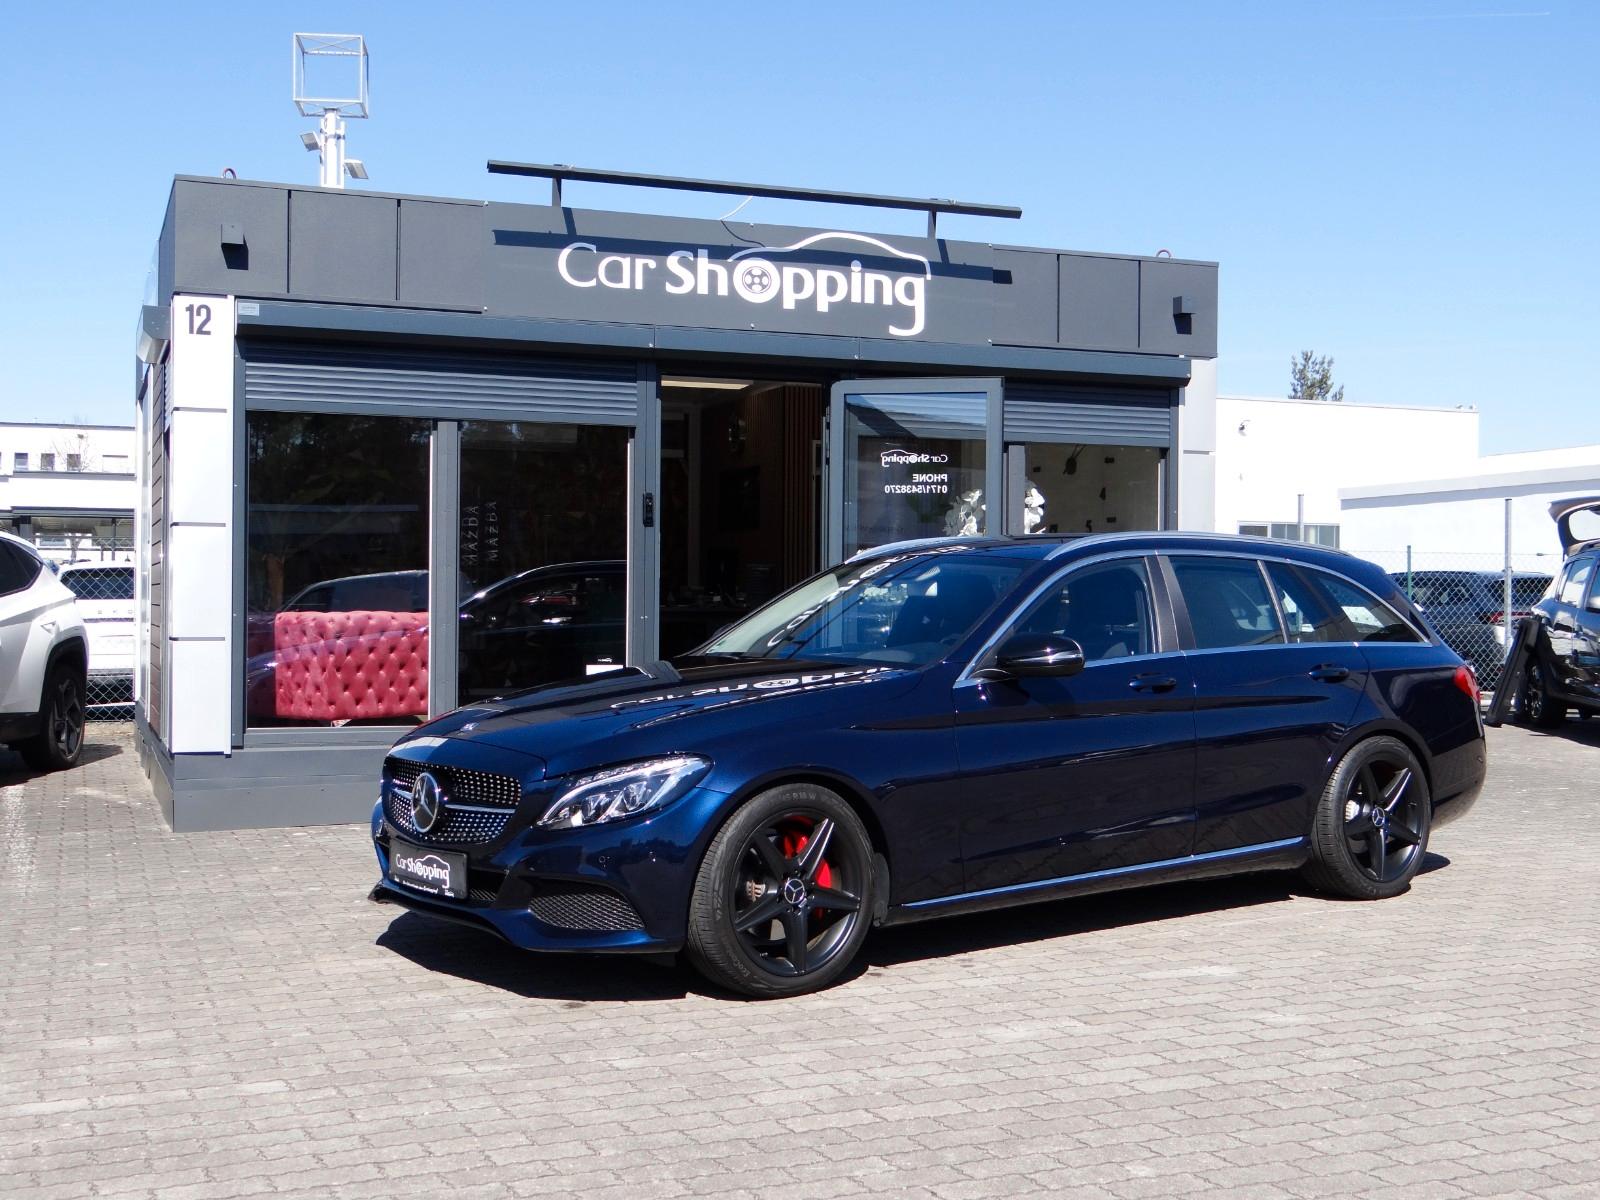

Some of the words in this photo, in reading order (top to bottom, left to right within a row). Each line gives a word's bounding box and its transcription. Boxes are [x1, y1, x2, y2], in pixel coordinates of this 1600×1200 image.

[557, 241, 657, 291] Car
[665, 248, 926, 337] Shopping
[185, 303, 212, 335] 12
[395, 853, 408, 870] Car
[407, 857, 450, 889] Shopping
